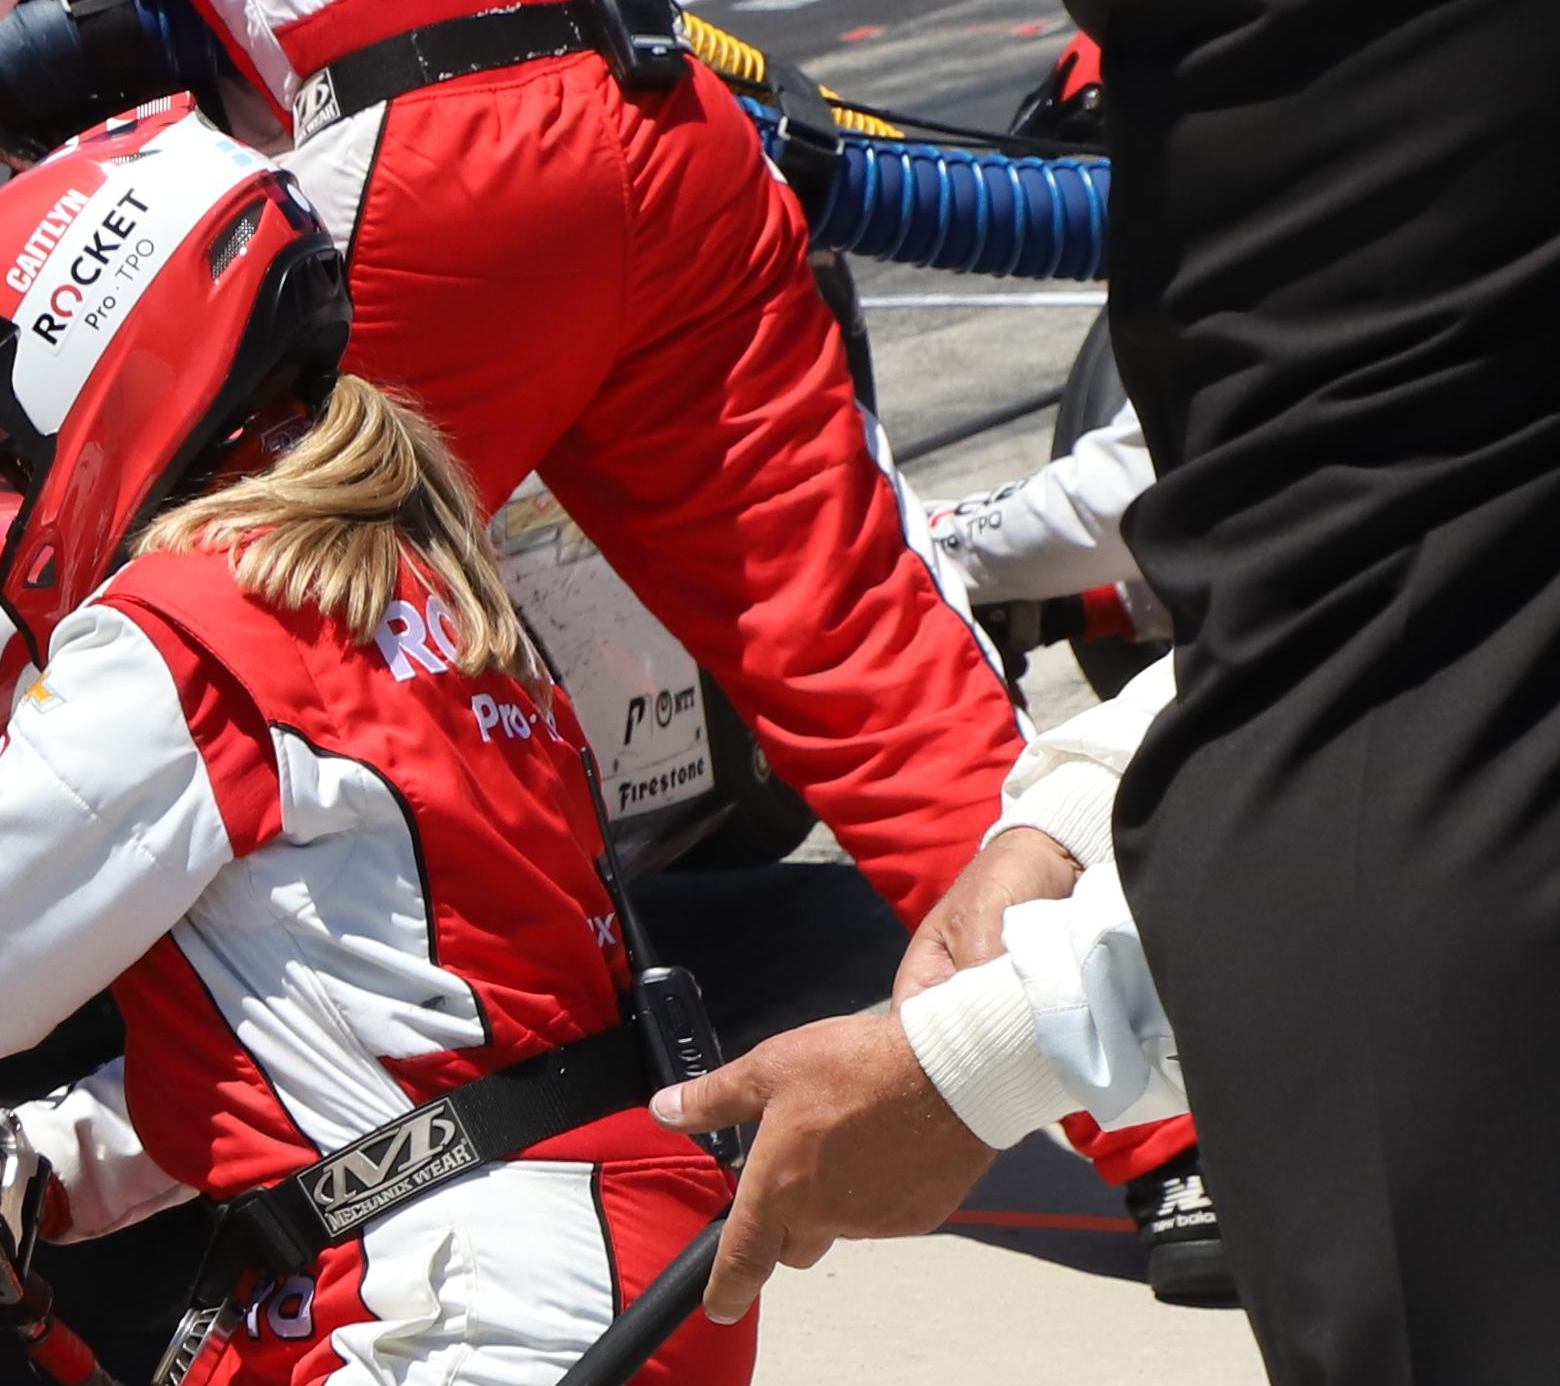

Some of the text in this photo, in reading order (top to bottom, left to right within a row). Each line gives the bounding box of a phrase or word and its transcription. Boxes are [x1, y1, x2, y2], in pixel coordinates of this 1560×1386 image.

[5, 188, 89, 295] CAITLYN
[32, 187, 149, 346] ROCKET
[84, 238, 155, 331] Pro TPO
[471, 694, 530, 740] Pro
[618, 758, 705, 811] Firestone
[324, 1143, 472, 1232] MECHANIX WEAR
